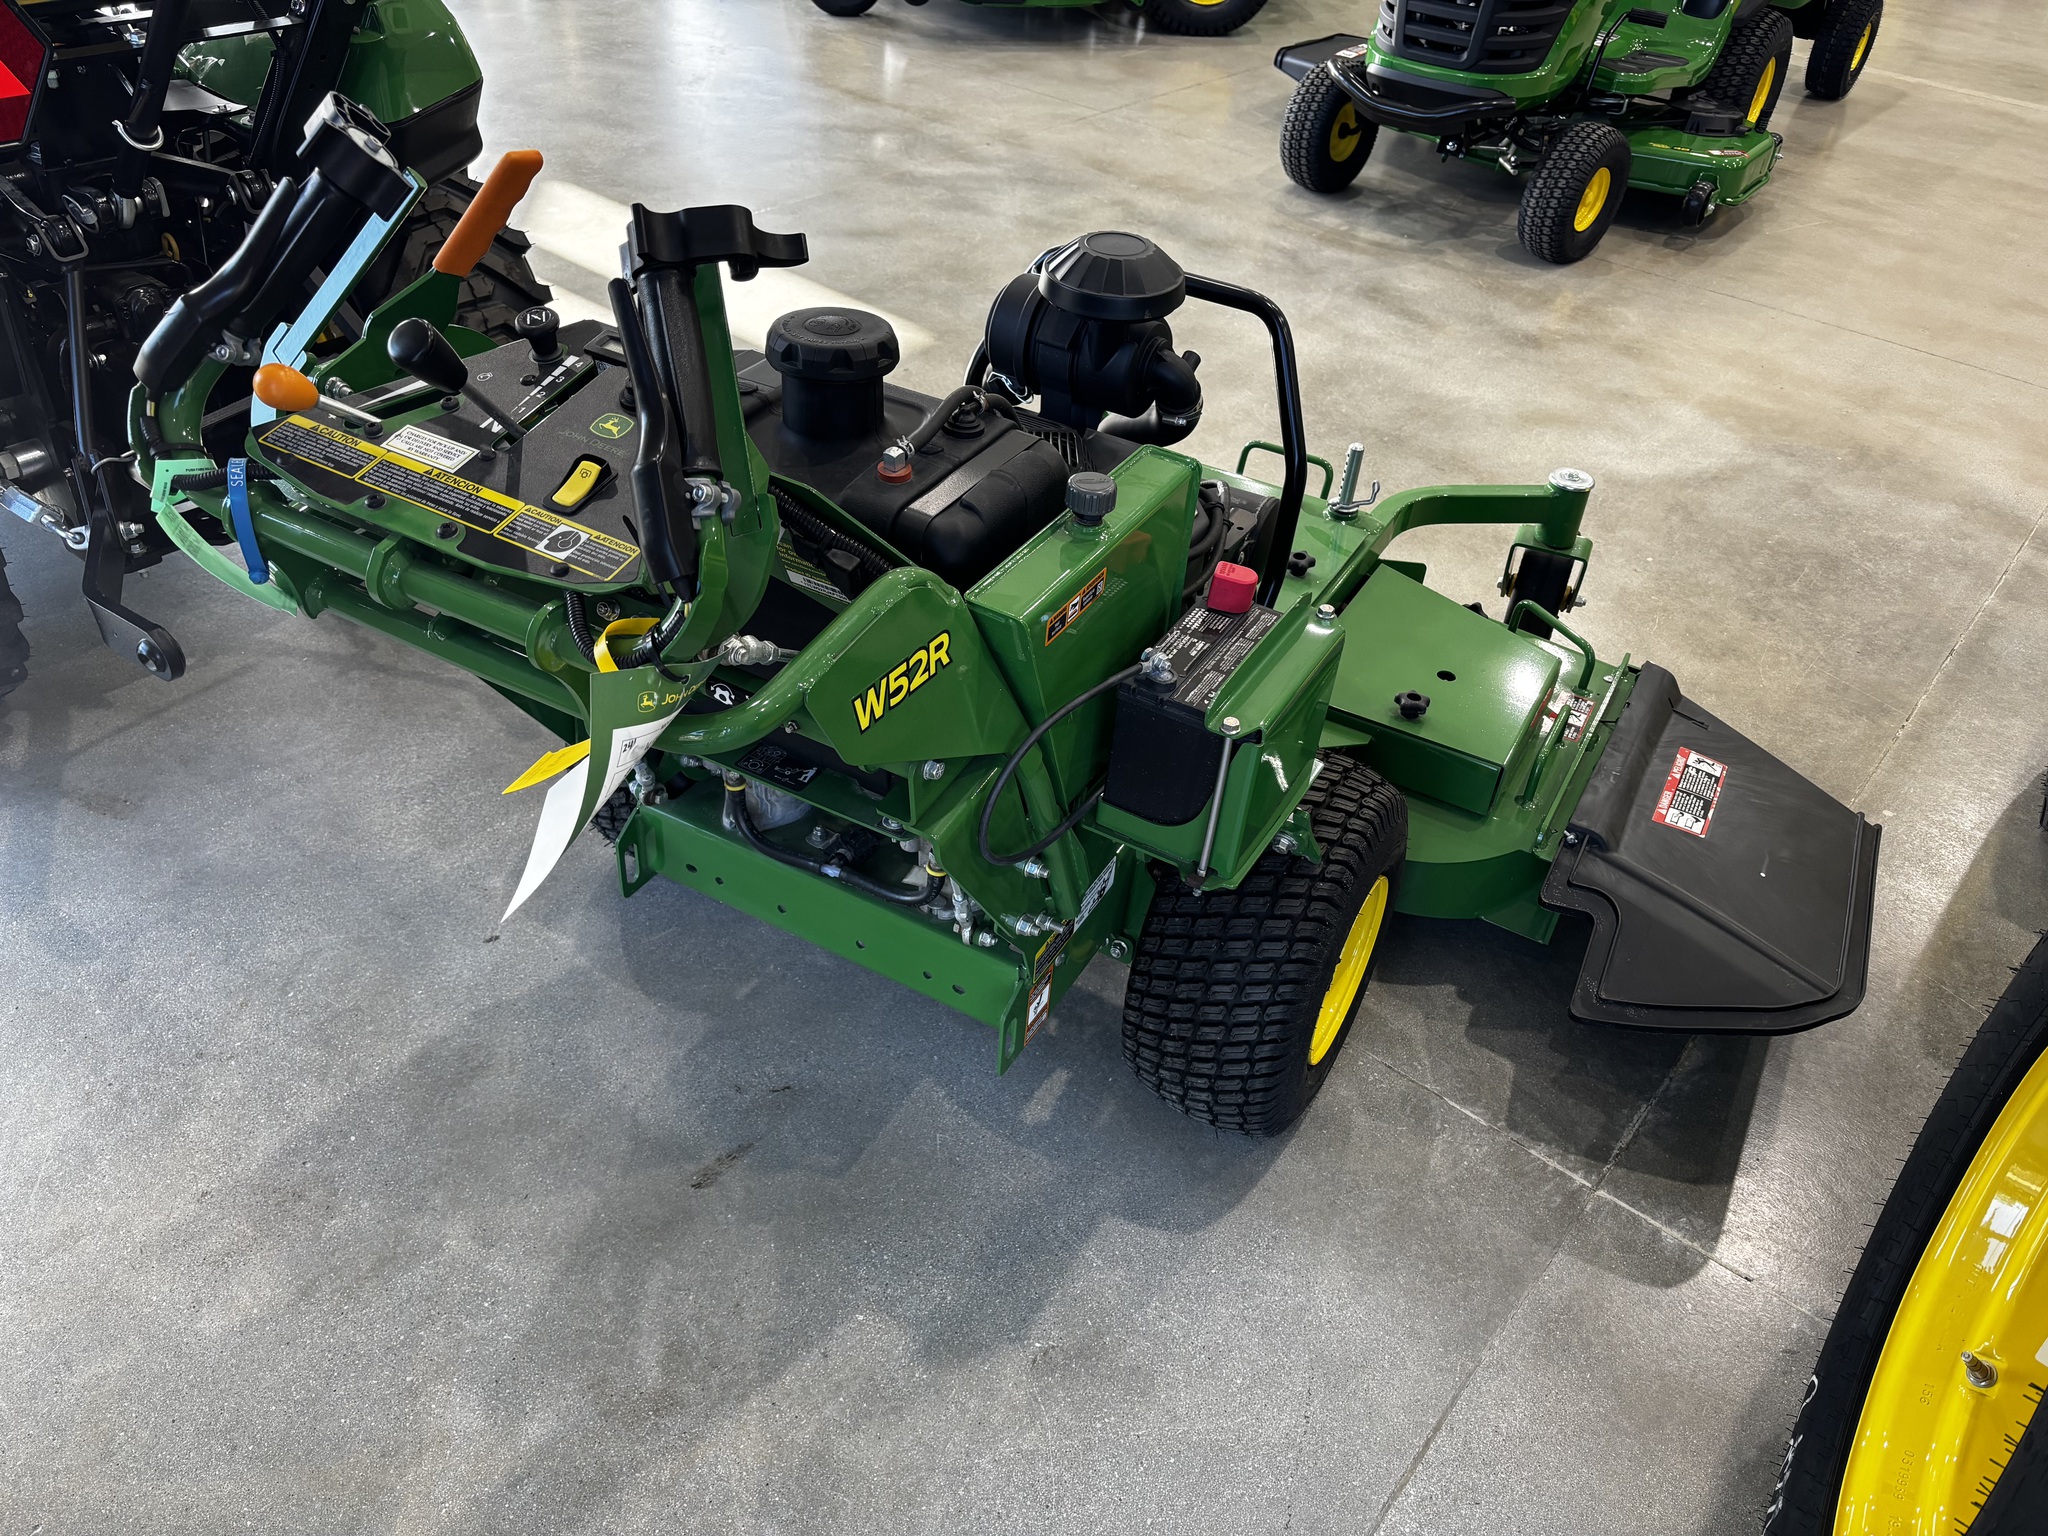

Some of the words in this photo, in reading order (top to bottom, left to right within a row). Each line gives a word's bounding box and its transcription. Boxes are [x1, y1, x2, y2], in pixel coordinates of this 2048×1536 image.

[318, 427, 362, 446] CAUTION
[405, 430, 428, 440] CHARGES
[559, 430, 589, 444] JOHN
[588, 438, 626, 457] DEERE
[410, 437, 432, 447] DELIVERY
[441, 449, 461, 458] SERVICE
[412, 448, 440, 460] WARRANTY
[432, 451, 456, 461] COVERED
[431, 471, 484, 494] ATENCION
[529, 508, 563, 524] CAUTION
[598, 536, 639, 554] ATENCION
[852, 630, 952, 734] W52R
[1658, 789, 1673, 809] DANGER
